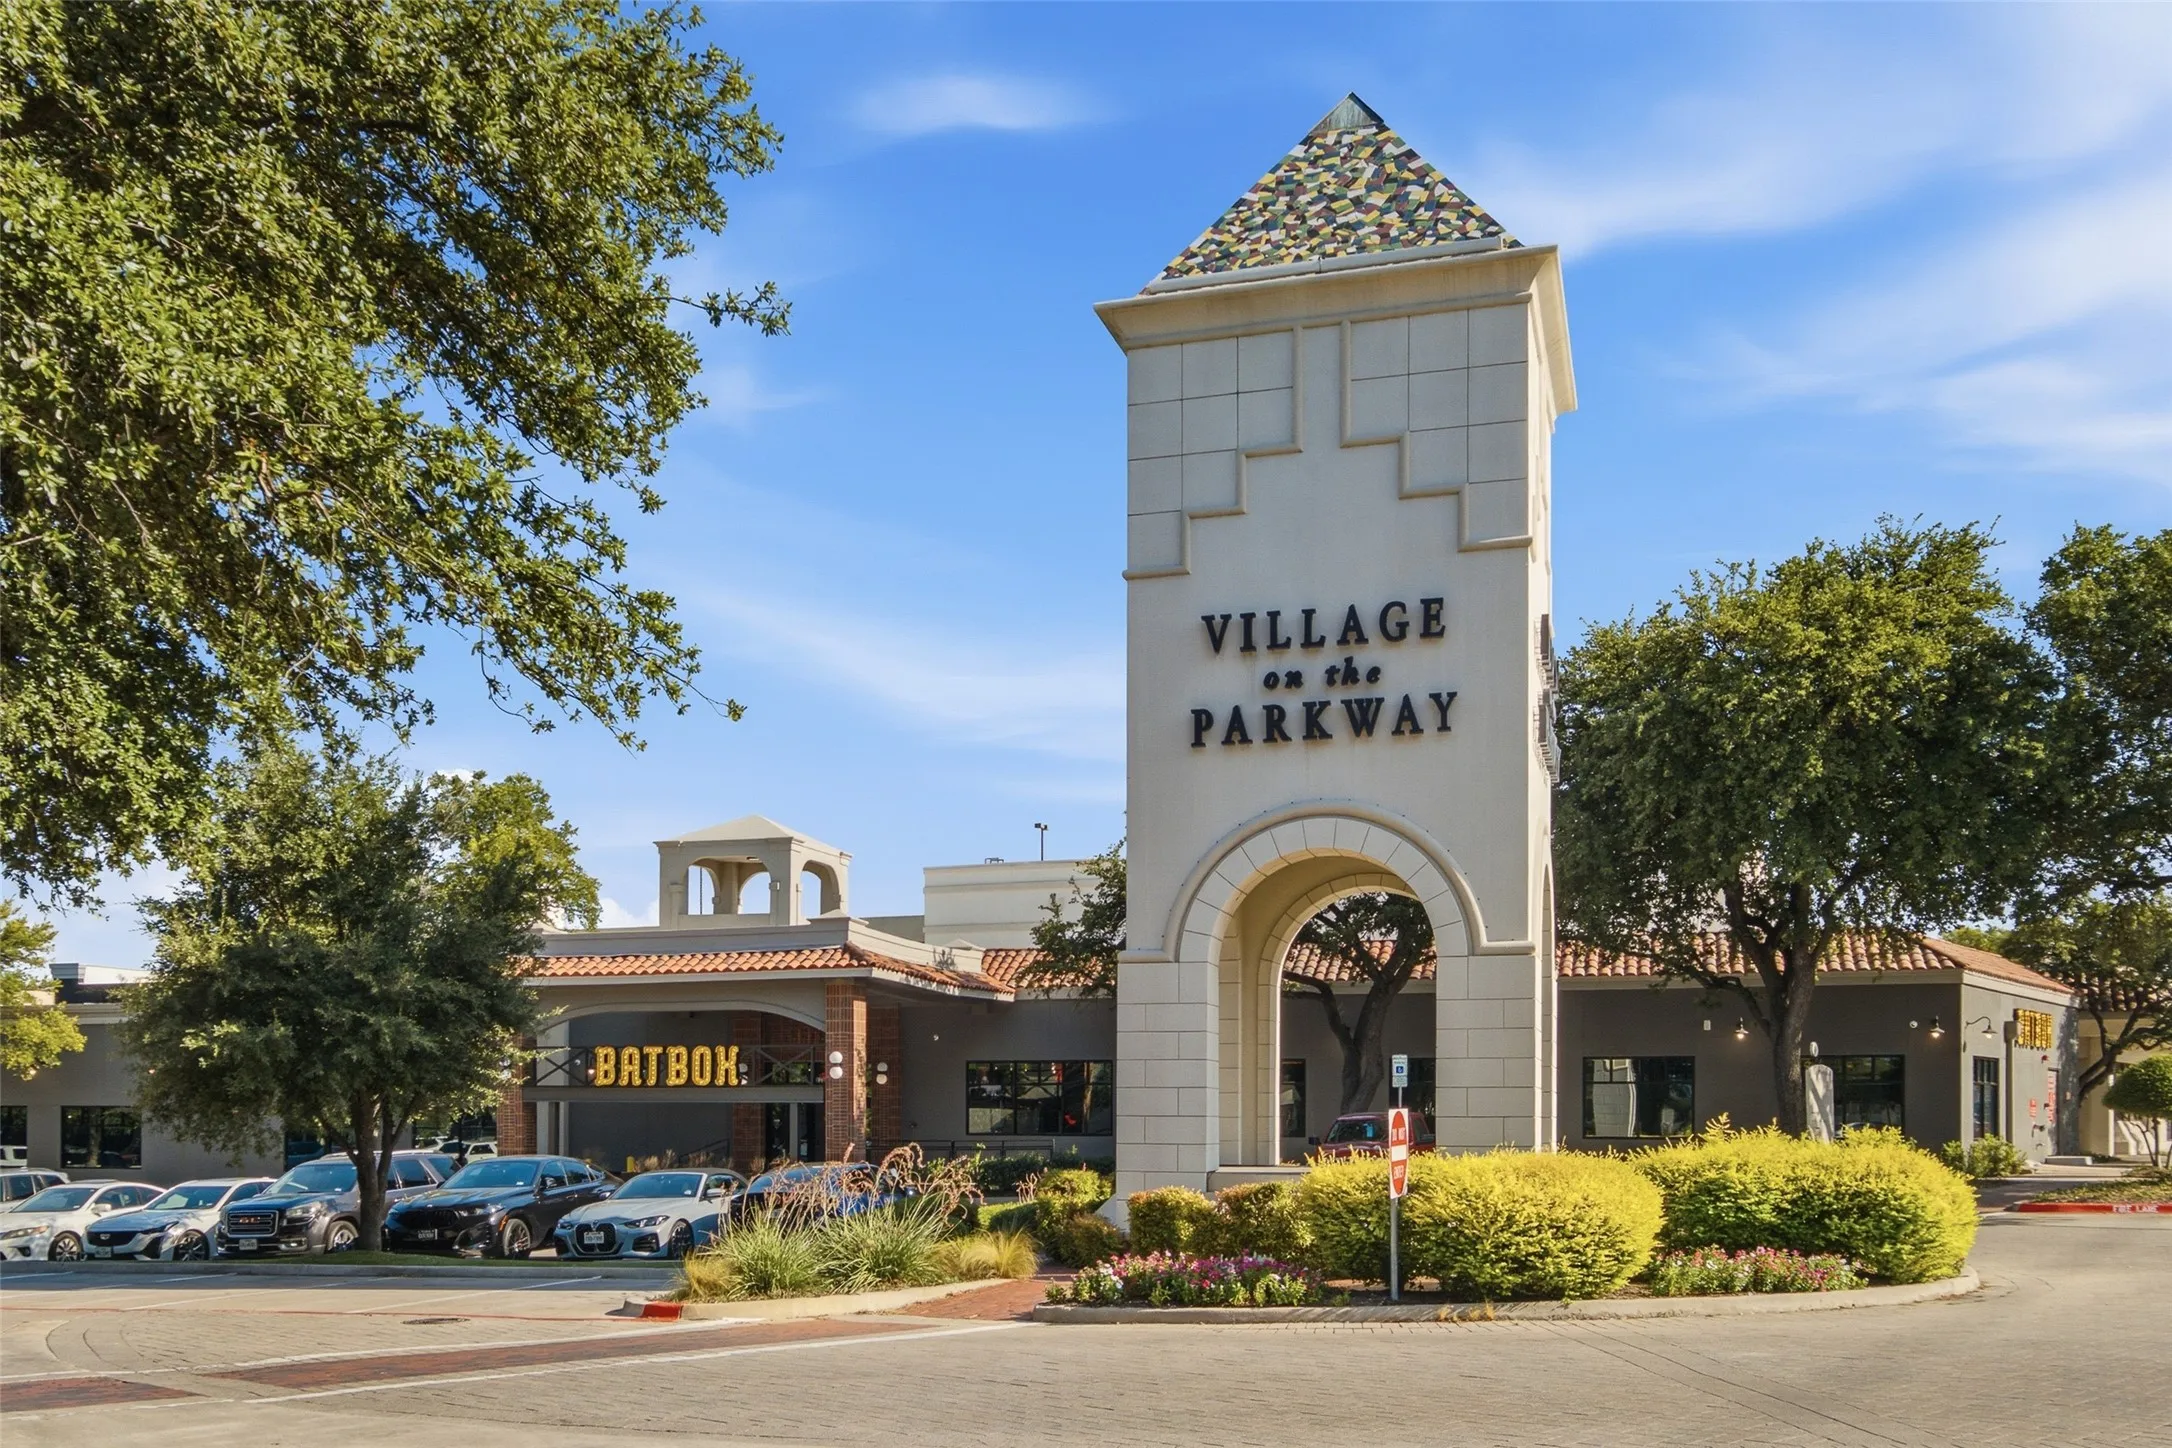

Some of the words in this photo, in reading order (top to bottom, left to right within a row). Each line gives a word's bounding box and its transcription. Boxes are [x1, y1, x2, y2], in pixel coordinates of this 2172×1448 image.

[1201, 597, 1447, 655] VILLAGE
[1263, 667, 1305, 690] on
[1324, 655, 1382, 688] the
[1190, 691, 1458, 748] PARKWAY
[594, 1045, 740, 1087] BATBOX
